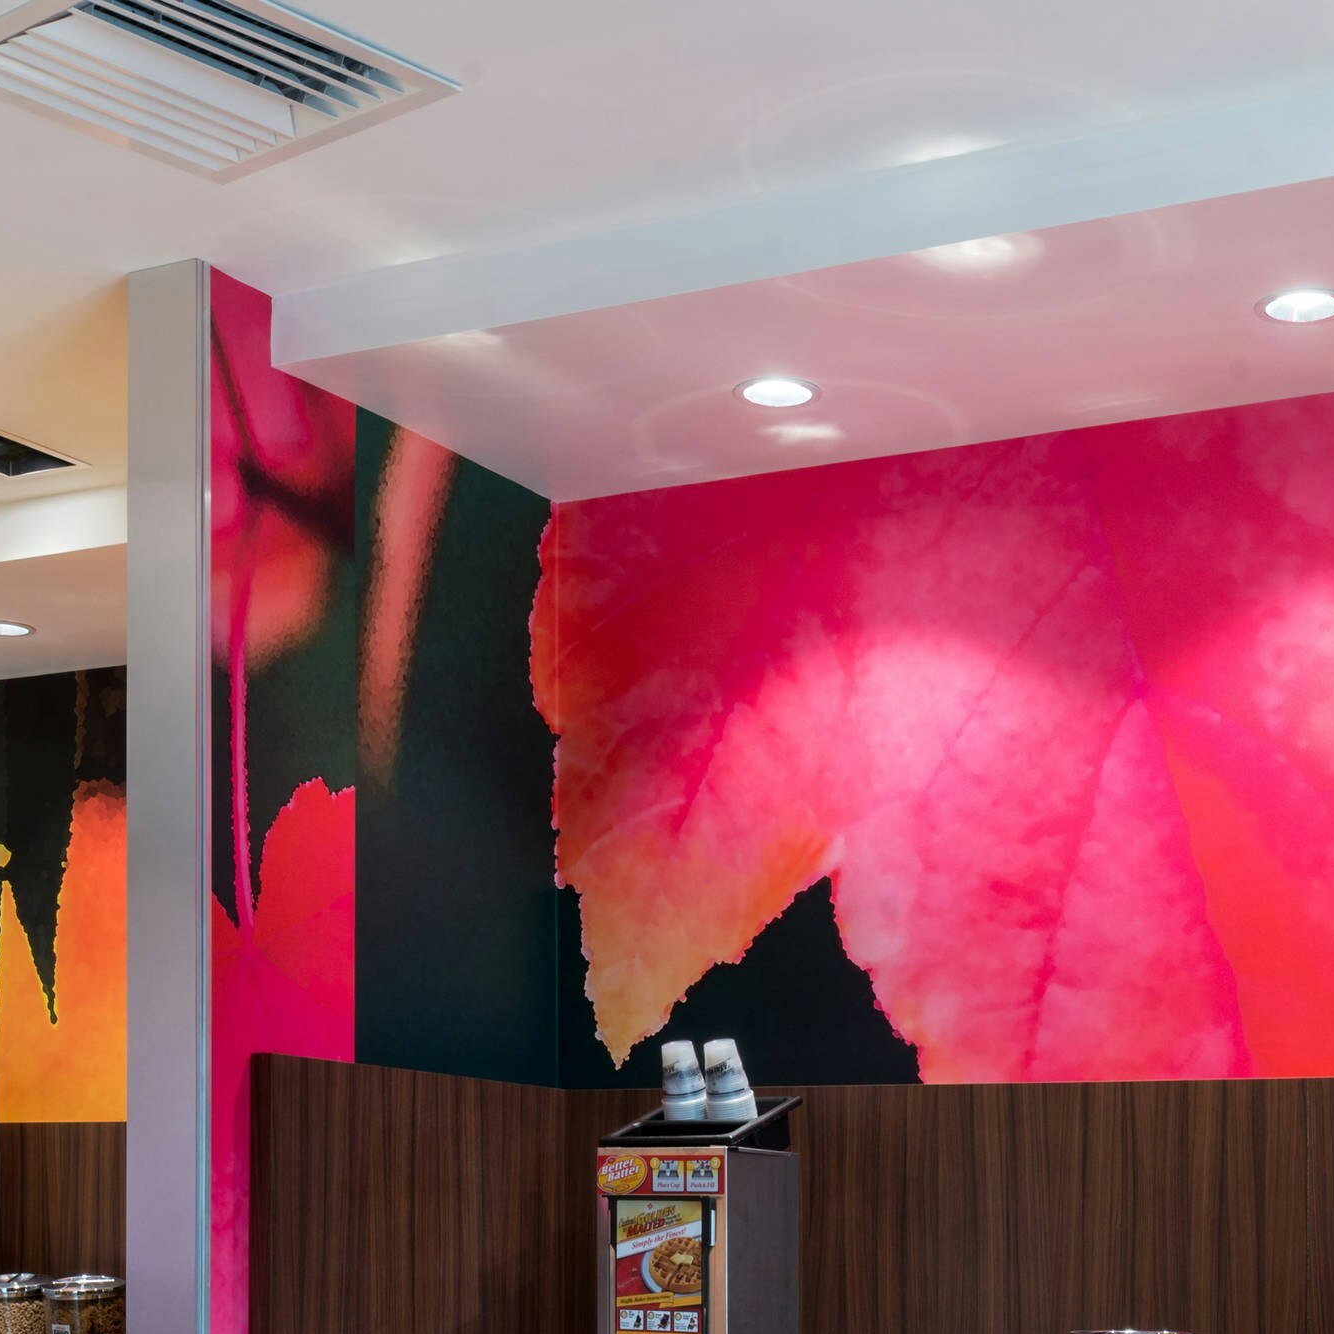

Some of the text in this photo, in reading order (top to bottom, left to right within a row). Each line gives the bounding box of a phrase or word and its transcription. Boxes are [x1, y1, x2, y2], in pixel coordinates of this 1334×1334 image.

[601, 1158, 634, 1176] Better
[607, 1165, 640, 1182] Batter
[631, 1238, 653, 1250] Simply
